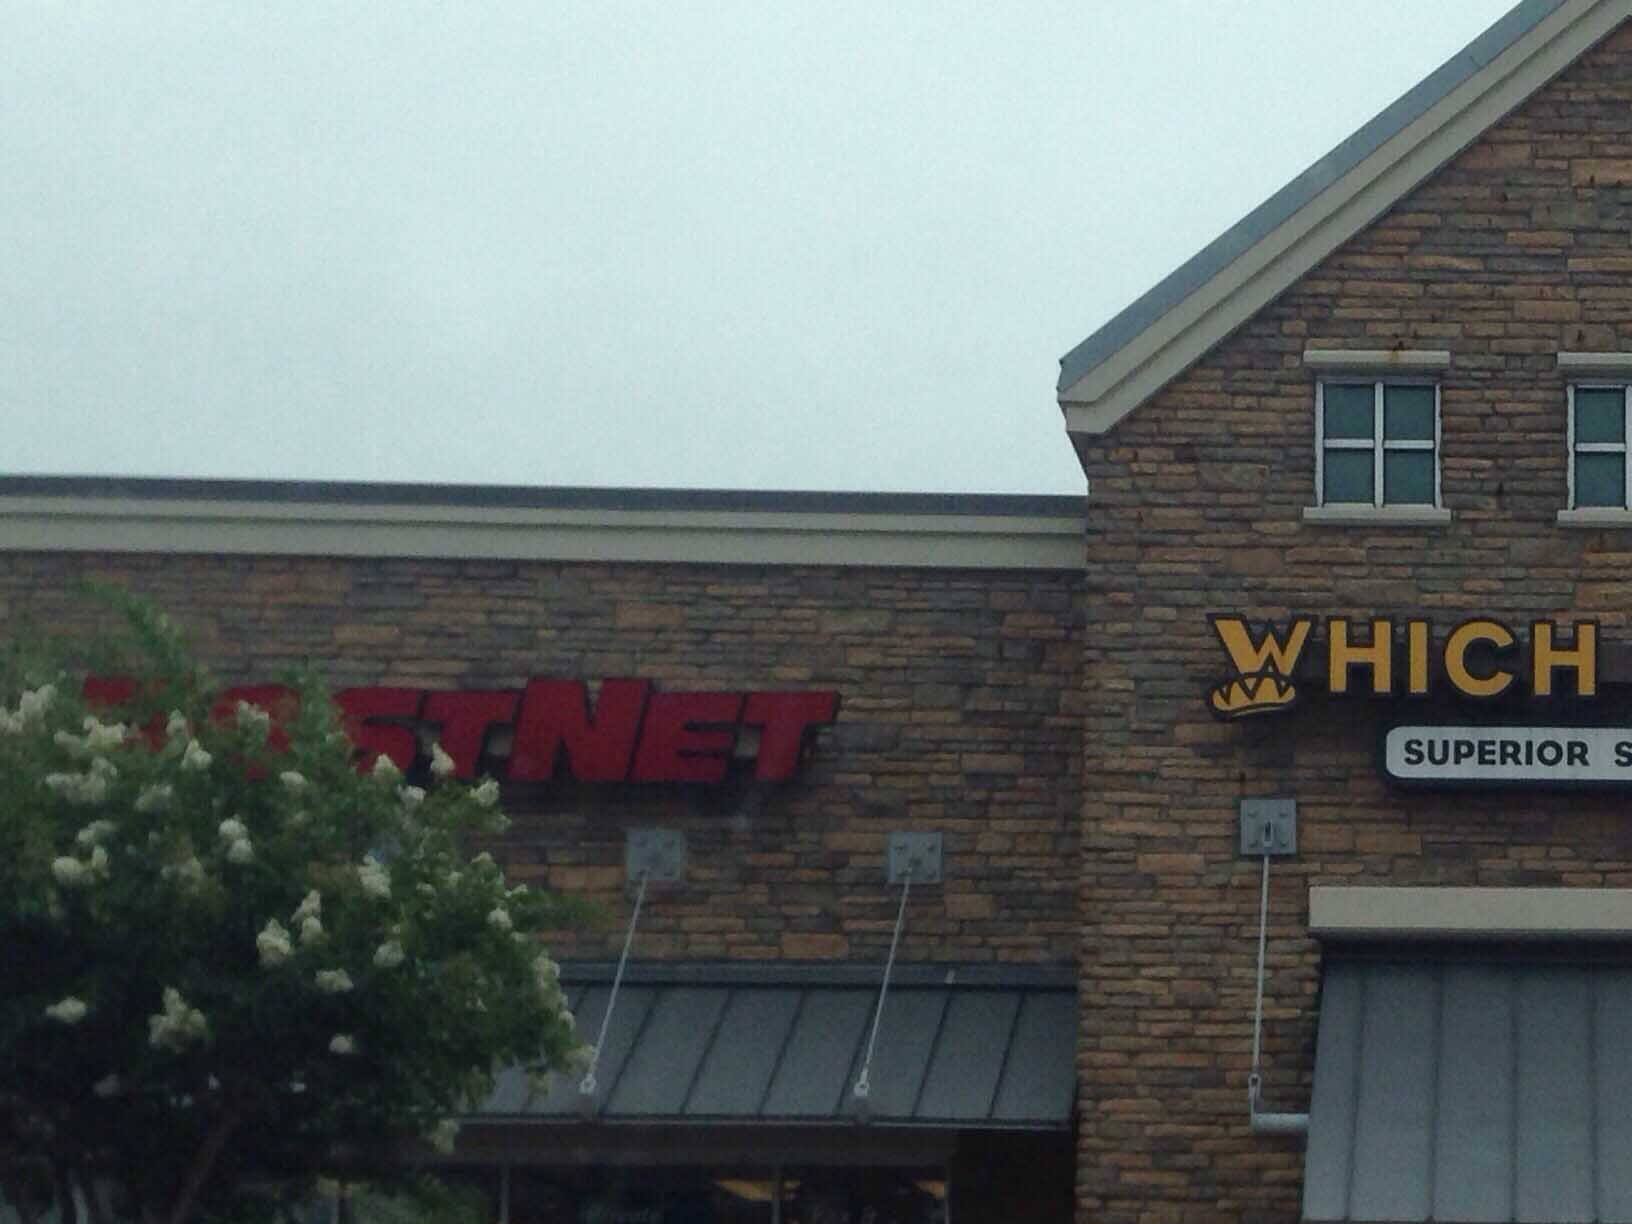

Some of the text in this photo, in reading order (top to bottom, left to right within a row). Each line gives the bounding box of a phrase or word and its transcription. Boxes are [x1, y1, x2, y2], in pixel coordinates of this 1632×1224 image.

[1207, 614, 1600, 706] WHICH
[82, 677, 840, 783] STNET
[1404, 739, 1590, 768] SUPERIOR
